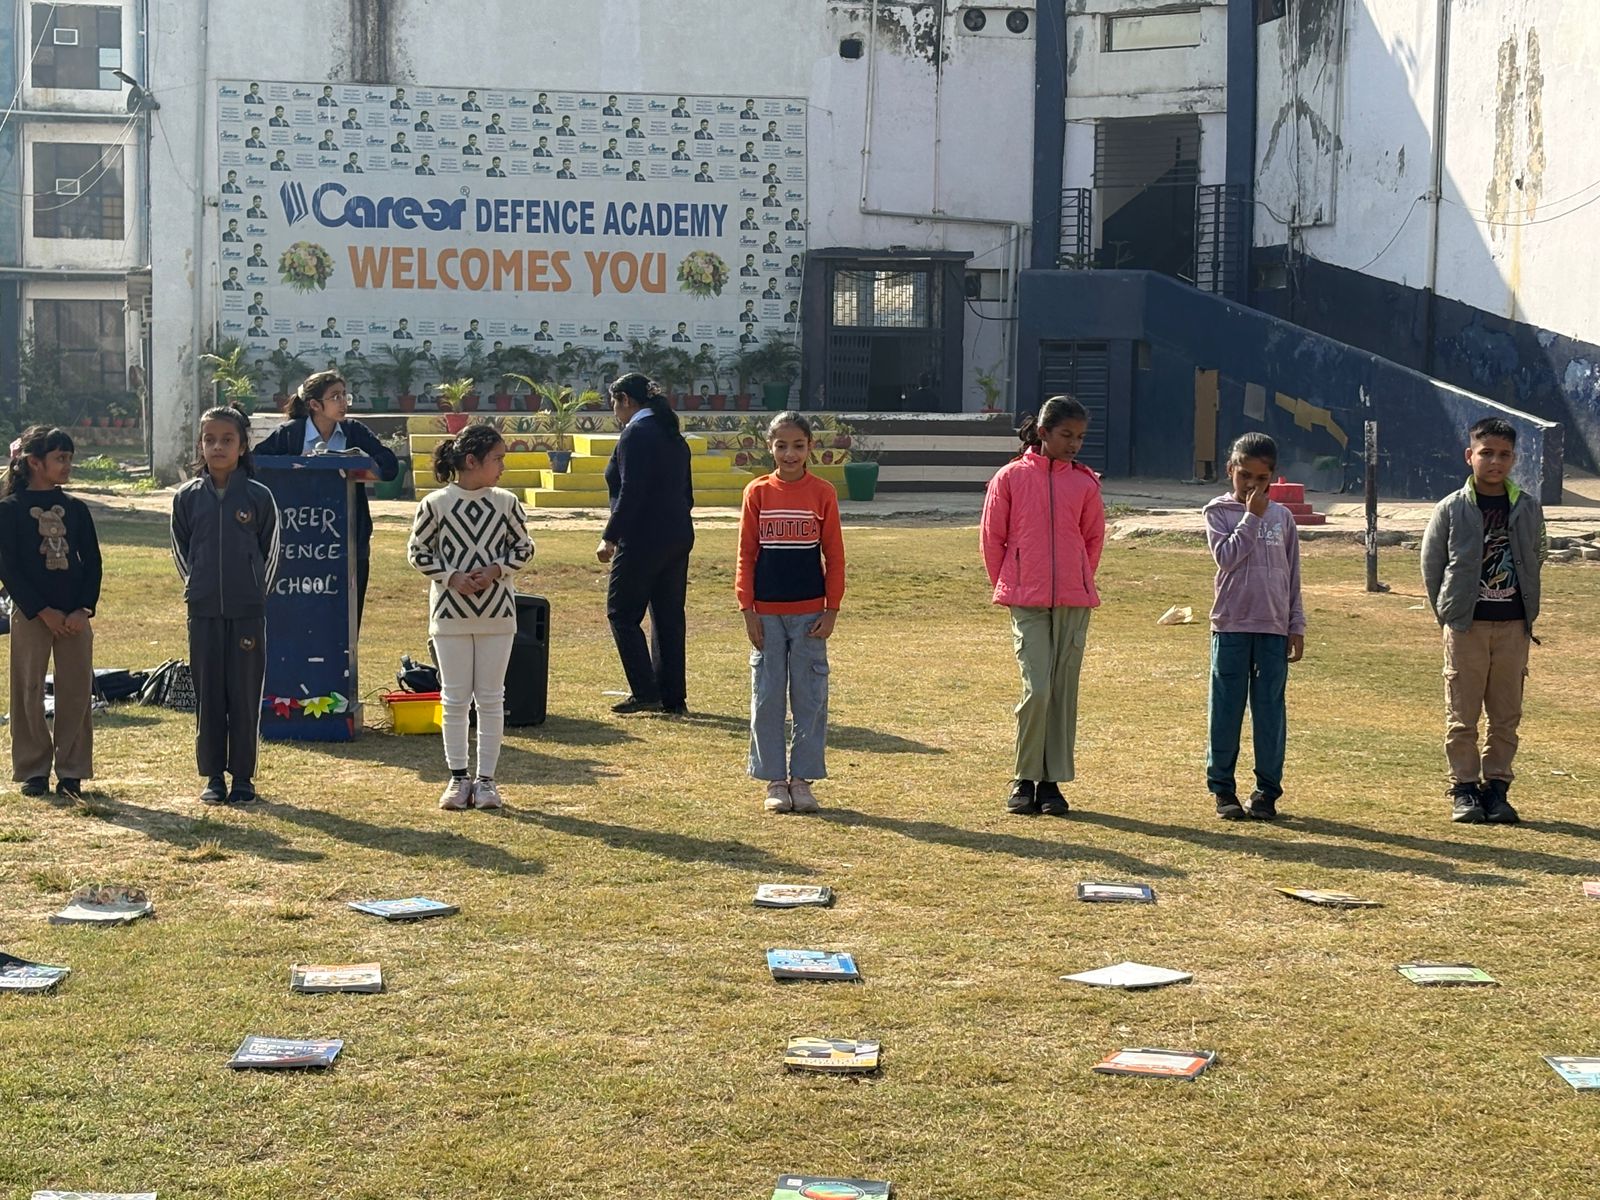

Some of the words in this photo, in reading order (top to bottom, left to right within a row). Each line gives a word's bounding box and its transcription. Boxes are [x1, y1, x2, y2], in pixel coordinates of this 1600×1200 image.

[311, 182, 467, 232] Career
[475, 198, 596, 235] DEFENCE
[602, 201, 729, 237] ACADEMY
[346, 245, 573, 293] WELCOMES
[584, 250, 667, 298] YOU
[279, 506, 341, 538] REER
[280, 543, 341, 560] ENCE
[272, 573, 339, 595] CHOOL
